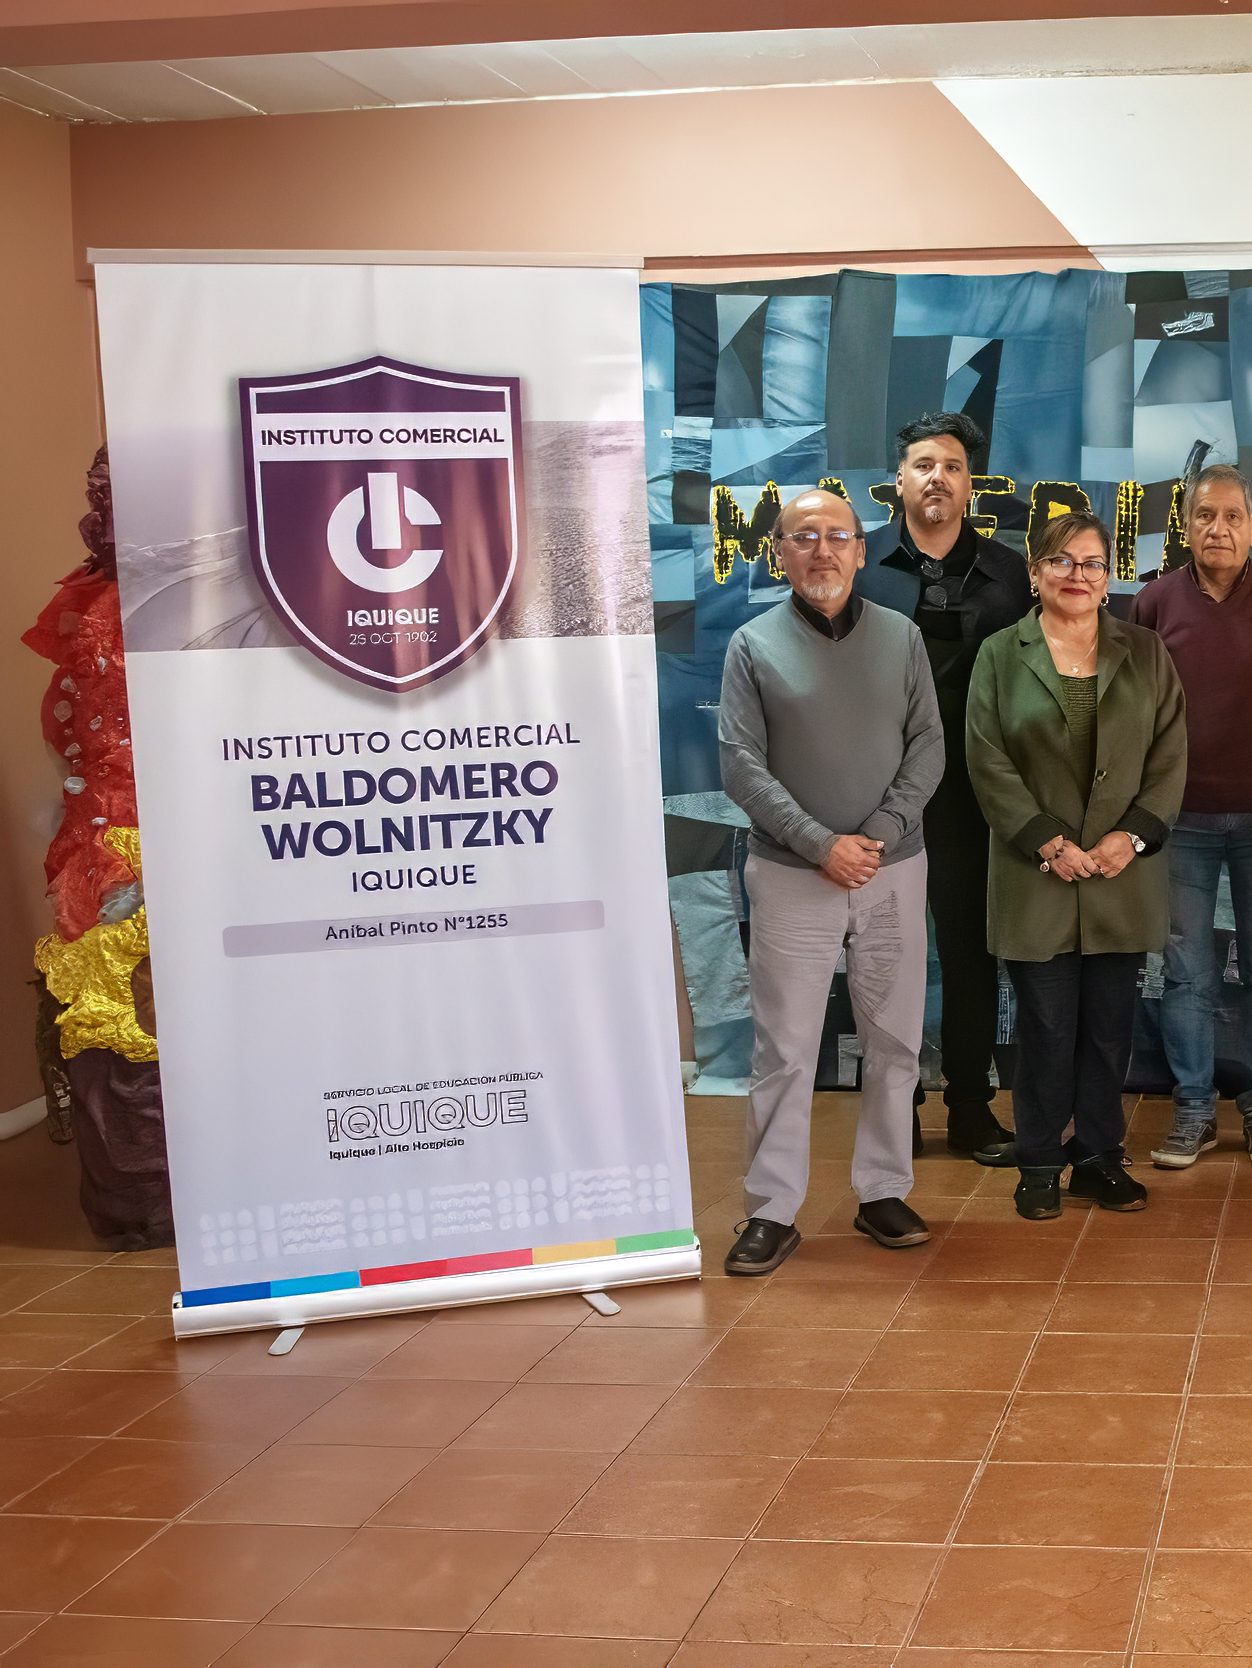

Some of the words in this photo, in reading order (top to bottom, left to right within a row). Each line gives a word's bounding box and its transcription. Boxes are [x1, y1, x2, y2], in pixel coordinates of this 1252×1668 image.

[261, 429, 374, 446] INSTITUTO
[379, 428, 505, 445] COMERCIAL
[347, 608, 439, 627] IQUIQUE
[369, 632, 401, 644] OCT
[405, 630, 437, 643] 1902
[222, 731, 391, 761] INSTITUTO
[400, 723, 581, 752] COMERCIAL
[251, 760, 559, 812] BALDOMERO
[261, 808, 554, 860] WOLNITZKY
[352, 864, 477, 892] IQUIQUE
[390, 921, 438, 936] Pinto
[378, 1084, 413, 1095] LOCAL
[416, 1082, 430, 1092] DE
[326, 1089, 529, 1142] IQUIQUE
[329, 1148, 376, 1161] Iquique
[385, 1144, 410, 1154] Alto
[412, 1137, 466, 1151] Hospicio
